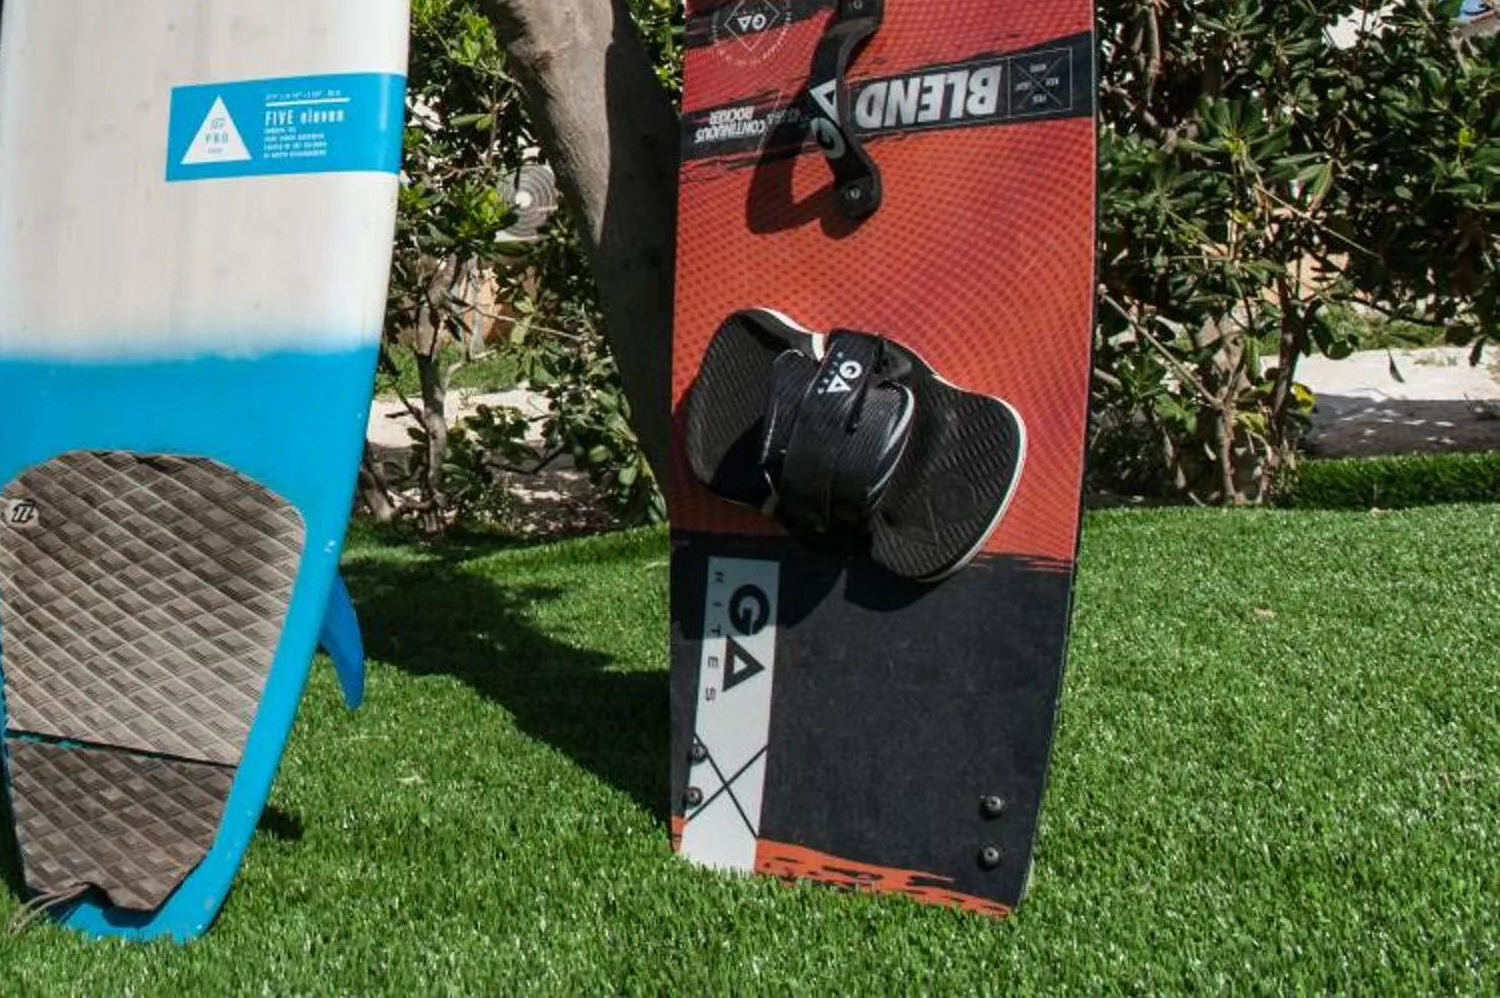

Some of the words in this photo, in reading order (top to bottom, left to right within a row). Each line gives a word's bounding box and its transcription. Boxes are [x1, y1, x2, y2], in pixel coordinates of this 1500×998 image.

[855, 64, 1002, 129] BLEND
[265, 109, 293, 126] FIVE
[708, 105, 756, 126] ROCKER
[694, 119, 766, 144] CONTINUOUS
[705, 570, 725, 702] KITES
